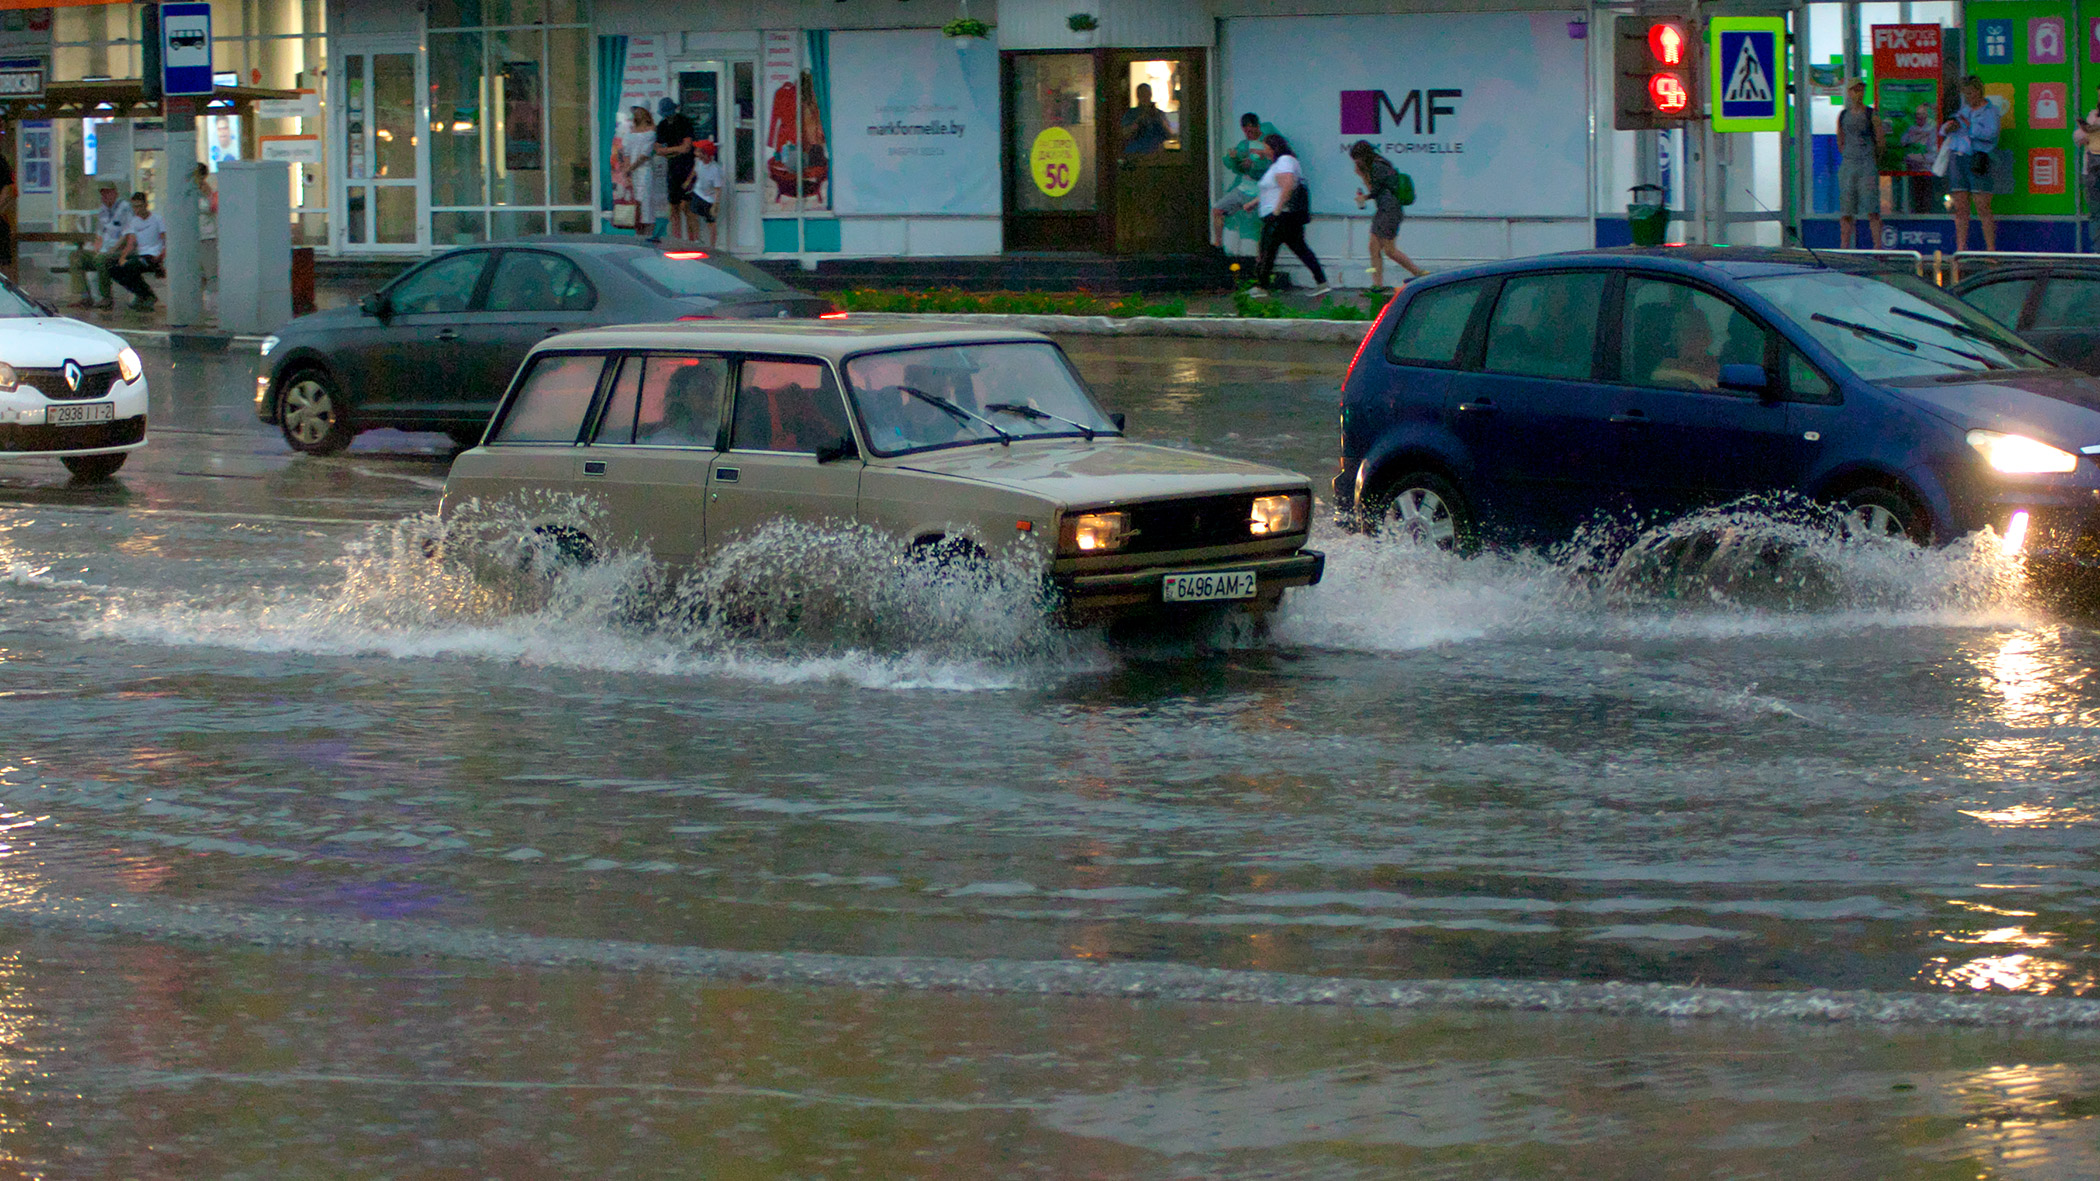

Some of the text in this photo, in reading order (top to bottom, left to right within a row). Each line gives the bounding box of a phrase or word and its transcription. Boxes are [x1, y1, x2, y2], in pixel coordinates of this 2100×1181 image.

[1895, 52, 1939, 68] WOW!
[1373, 89, 1462, 135] MF
[866, 120, 966, 138] markformelle.by
[1385, 143, 1463, 154] FORMELLE
[58, 406, 83, 422] 2938
[1178, 576, 1213, 598] 6496
